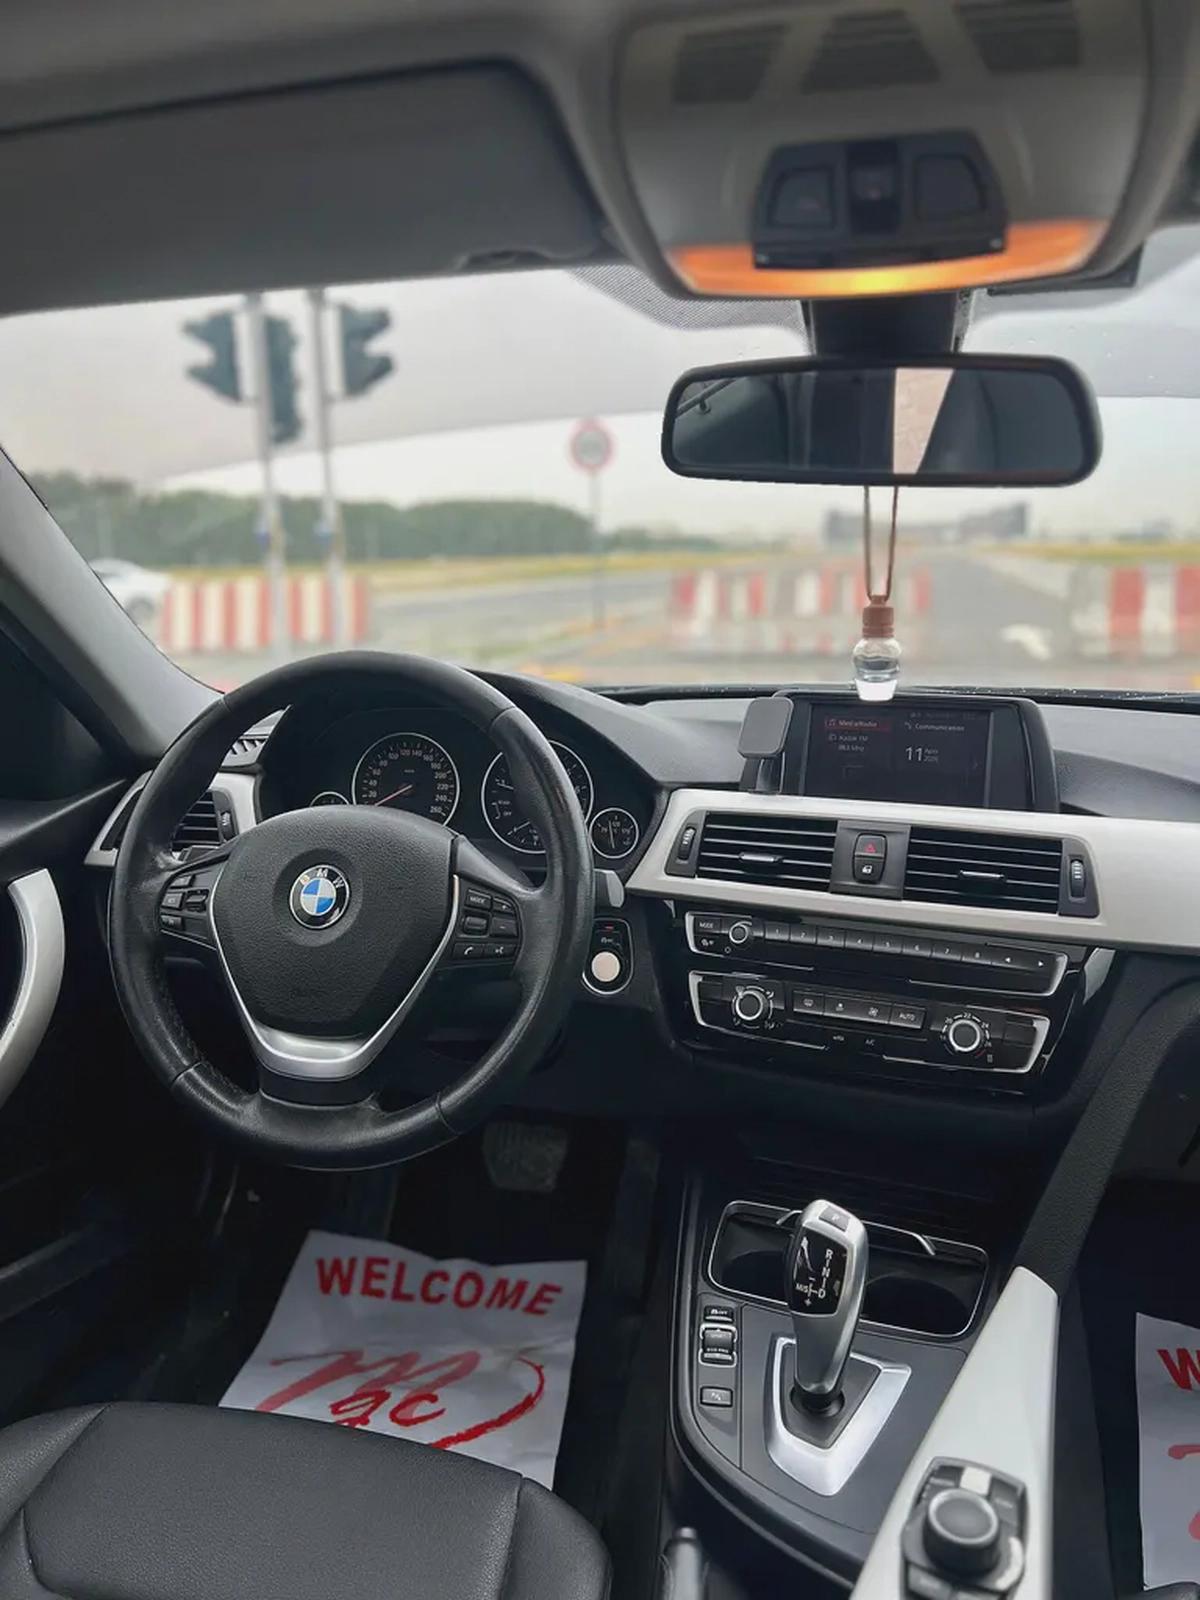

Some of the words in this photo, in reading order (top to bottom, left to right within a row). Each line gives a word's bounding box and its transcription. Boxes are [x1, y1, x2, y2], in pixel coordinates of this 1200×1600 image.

[905, 746, 922, 761] 11
[300, 868, 345, 889] BMW
[825, 1248, 834, 1260] R
[821, 1266, 831, 1278] N
[316, 1256, 563, 1317] WELCOME
[818, 1287, 826, 1299] D
